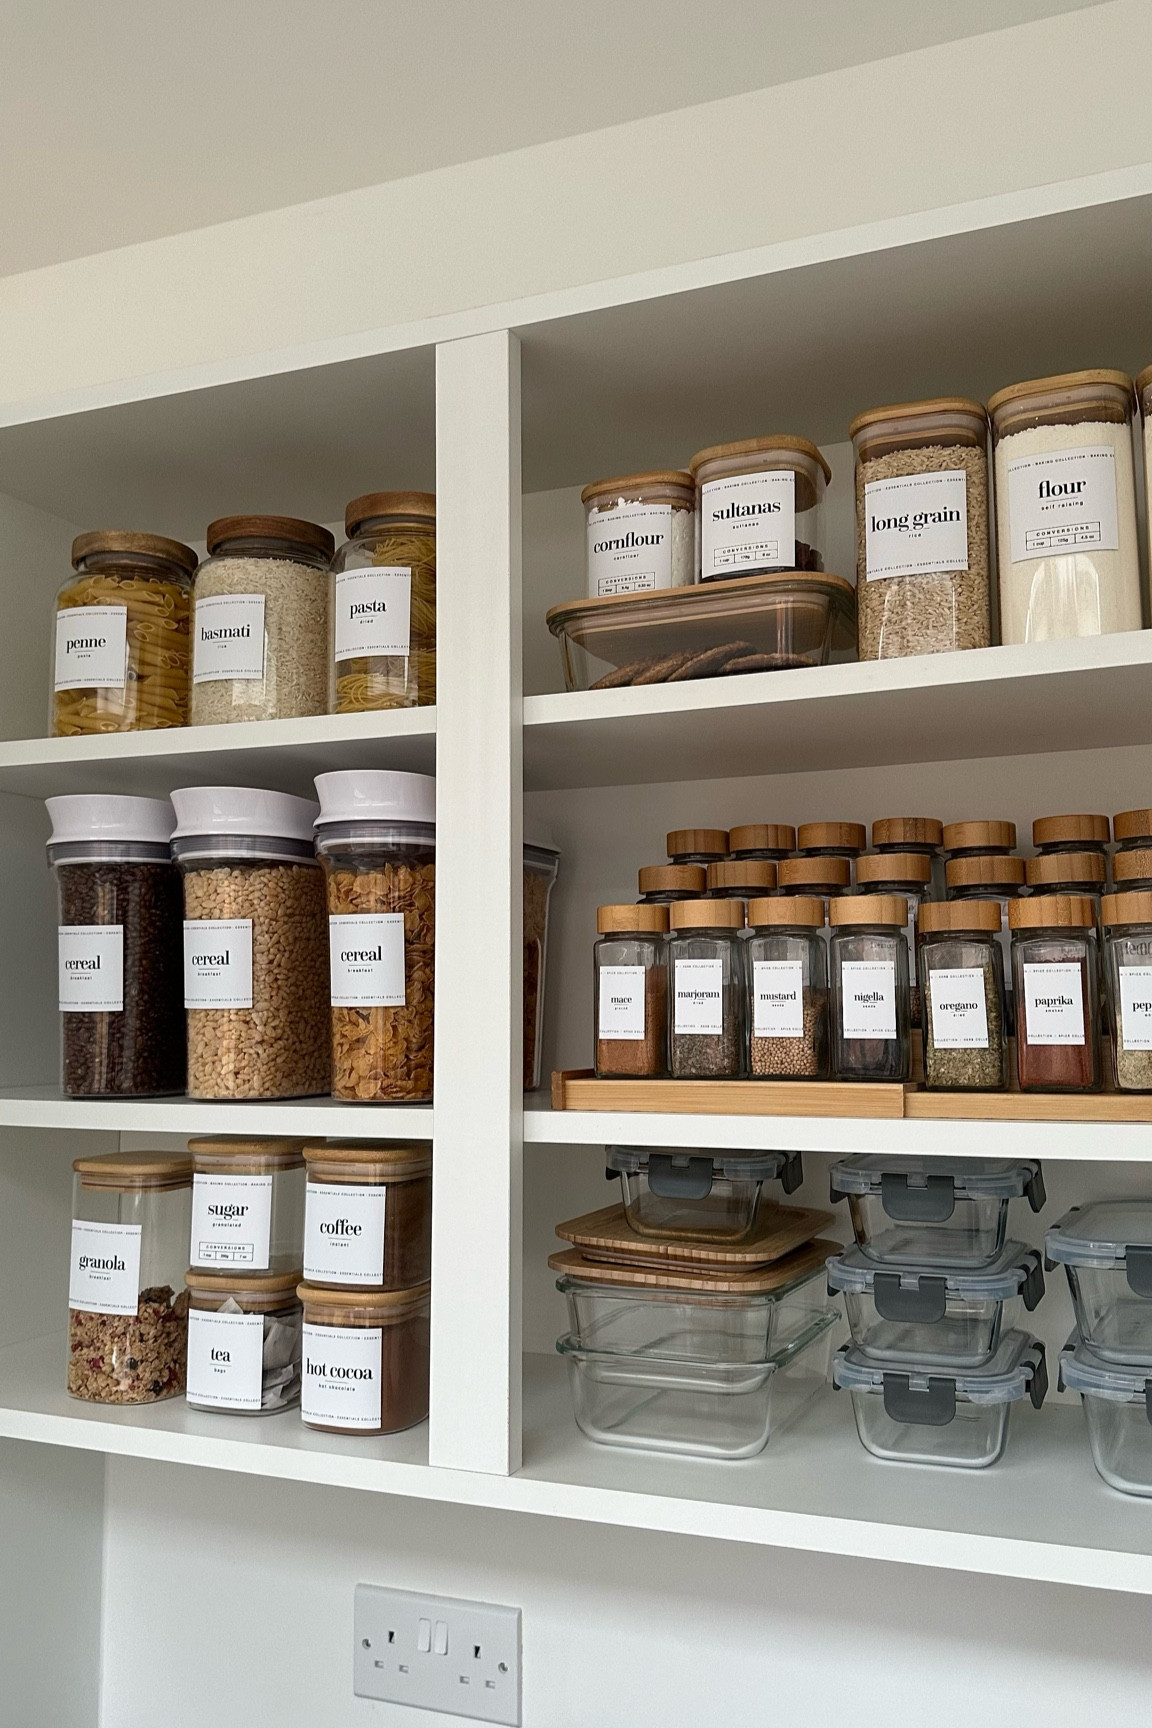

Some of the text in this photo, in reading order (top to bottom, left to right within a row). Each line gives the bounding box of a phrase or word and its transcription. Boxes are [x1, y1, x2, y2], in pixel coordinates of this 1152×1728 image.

[1039, 480, 1087, 499] flour
[712, 502, 781, 522] sultanas
[871, 506, 961, 533] long grain
[1036, 526, 1090, 537] CONVERSIONS
[594, 532, 664, 554] cornflour
[723, 544, 768, 554] CONVERSIONS
[350, 600, 387, 620] pasta
[201, 624, 250, 641] basmati
[66, 638, 106, 654] penne
[192, 950, 230, 966] cereal
[341, 946, 382, 962] cereal
[65, 955, 101, 970] cereal
[678, 989, 720, 1000] marjoram
[760, 991, 796, 1000] mustard
[854, 992, 884, 1003] nigella
[1035, 996, 1073, 1008] paprika
[940, 1002, 978, 1012] oregano
[208, 1204, 249, 1220] sugar
[320, 1219, 362, 1236] coffee
[79, 1255, 126, 1271] granola
[211, 1347, 231, 1362] tea
[306, 1358, 373, 1380] hot cocoa
